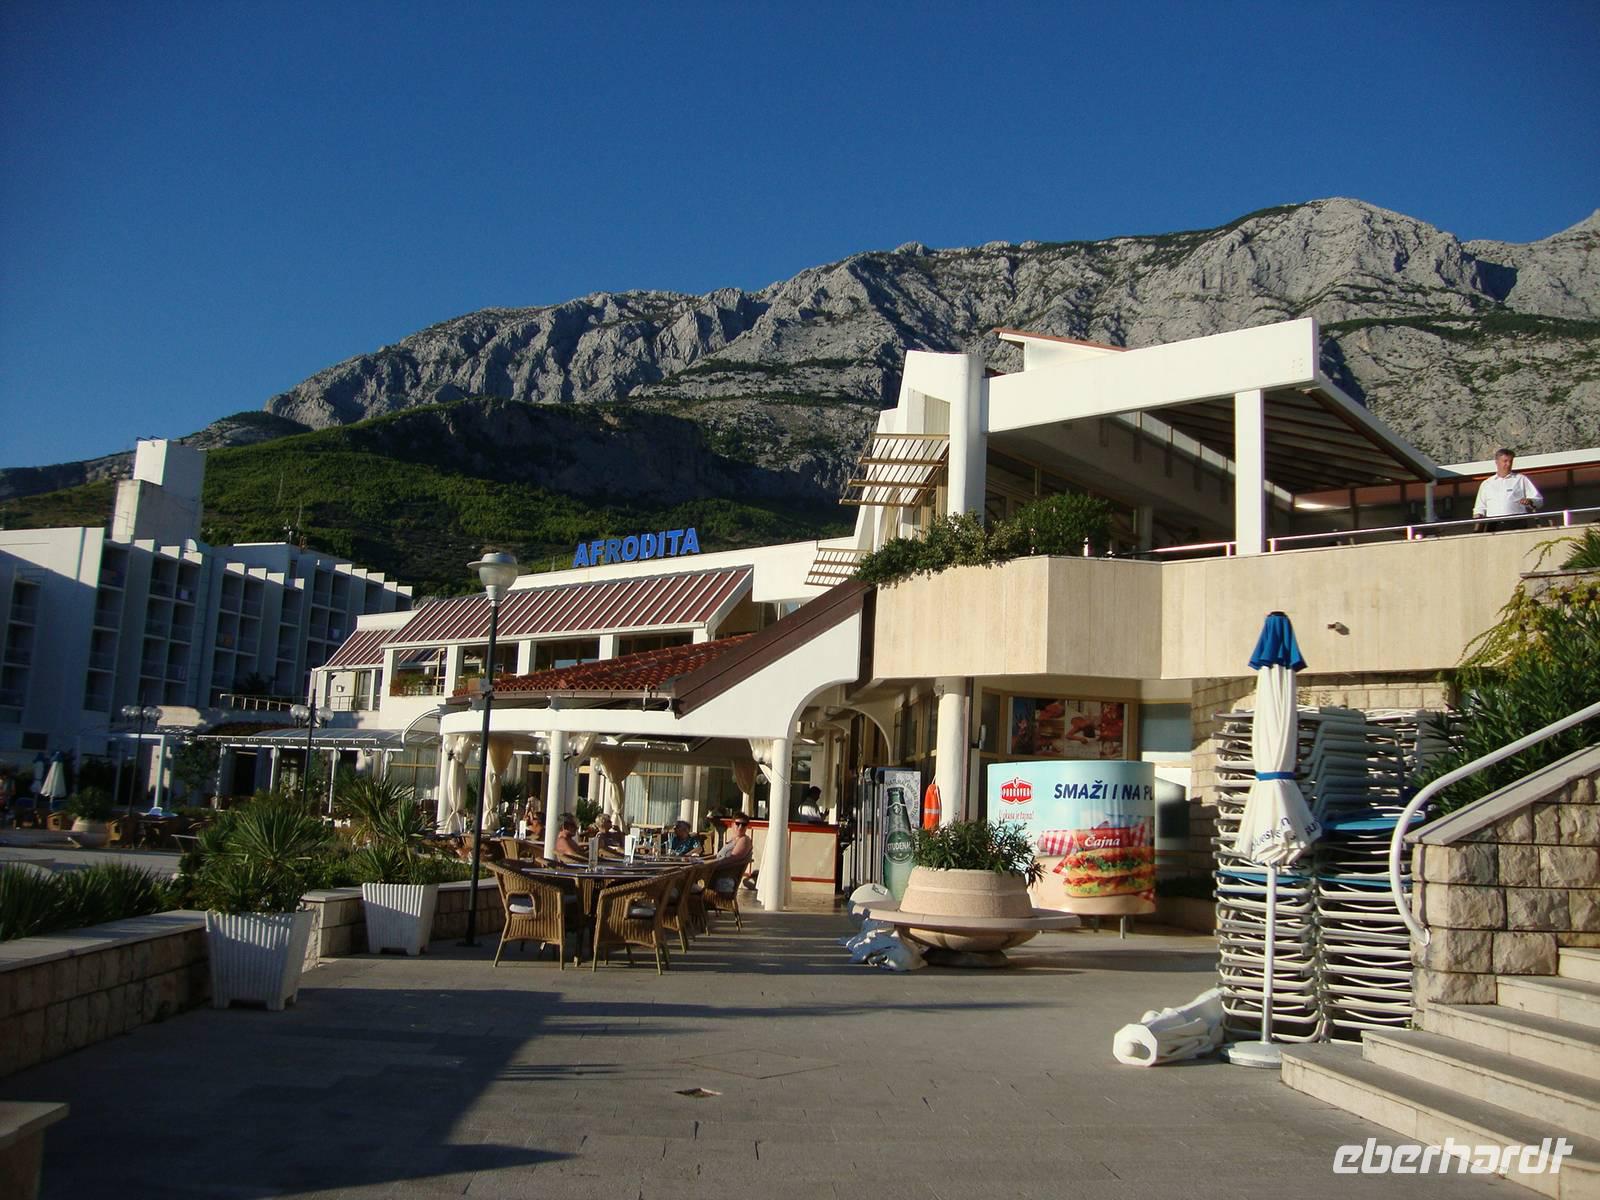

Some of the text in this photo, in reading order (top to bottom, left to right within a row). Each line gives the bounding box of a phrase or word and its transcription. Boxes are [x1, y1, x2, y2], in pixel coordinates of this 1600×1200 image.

[572, 527, 700, 569] AFRODITA
[1054, 780, 1108, 800] SMAŽI
[1111, 783, 1119, 800] I
[1121, 784, 1141, 800] NA
[1084, 833, 1120, 848] Čajna
